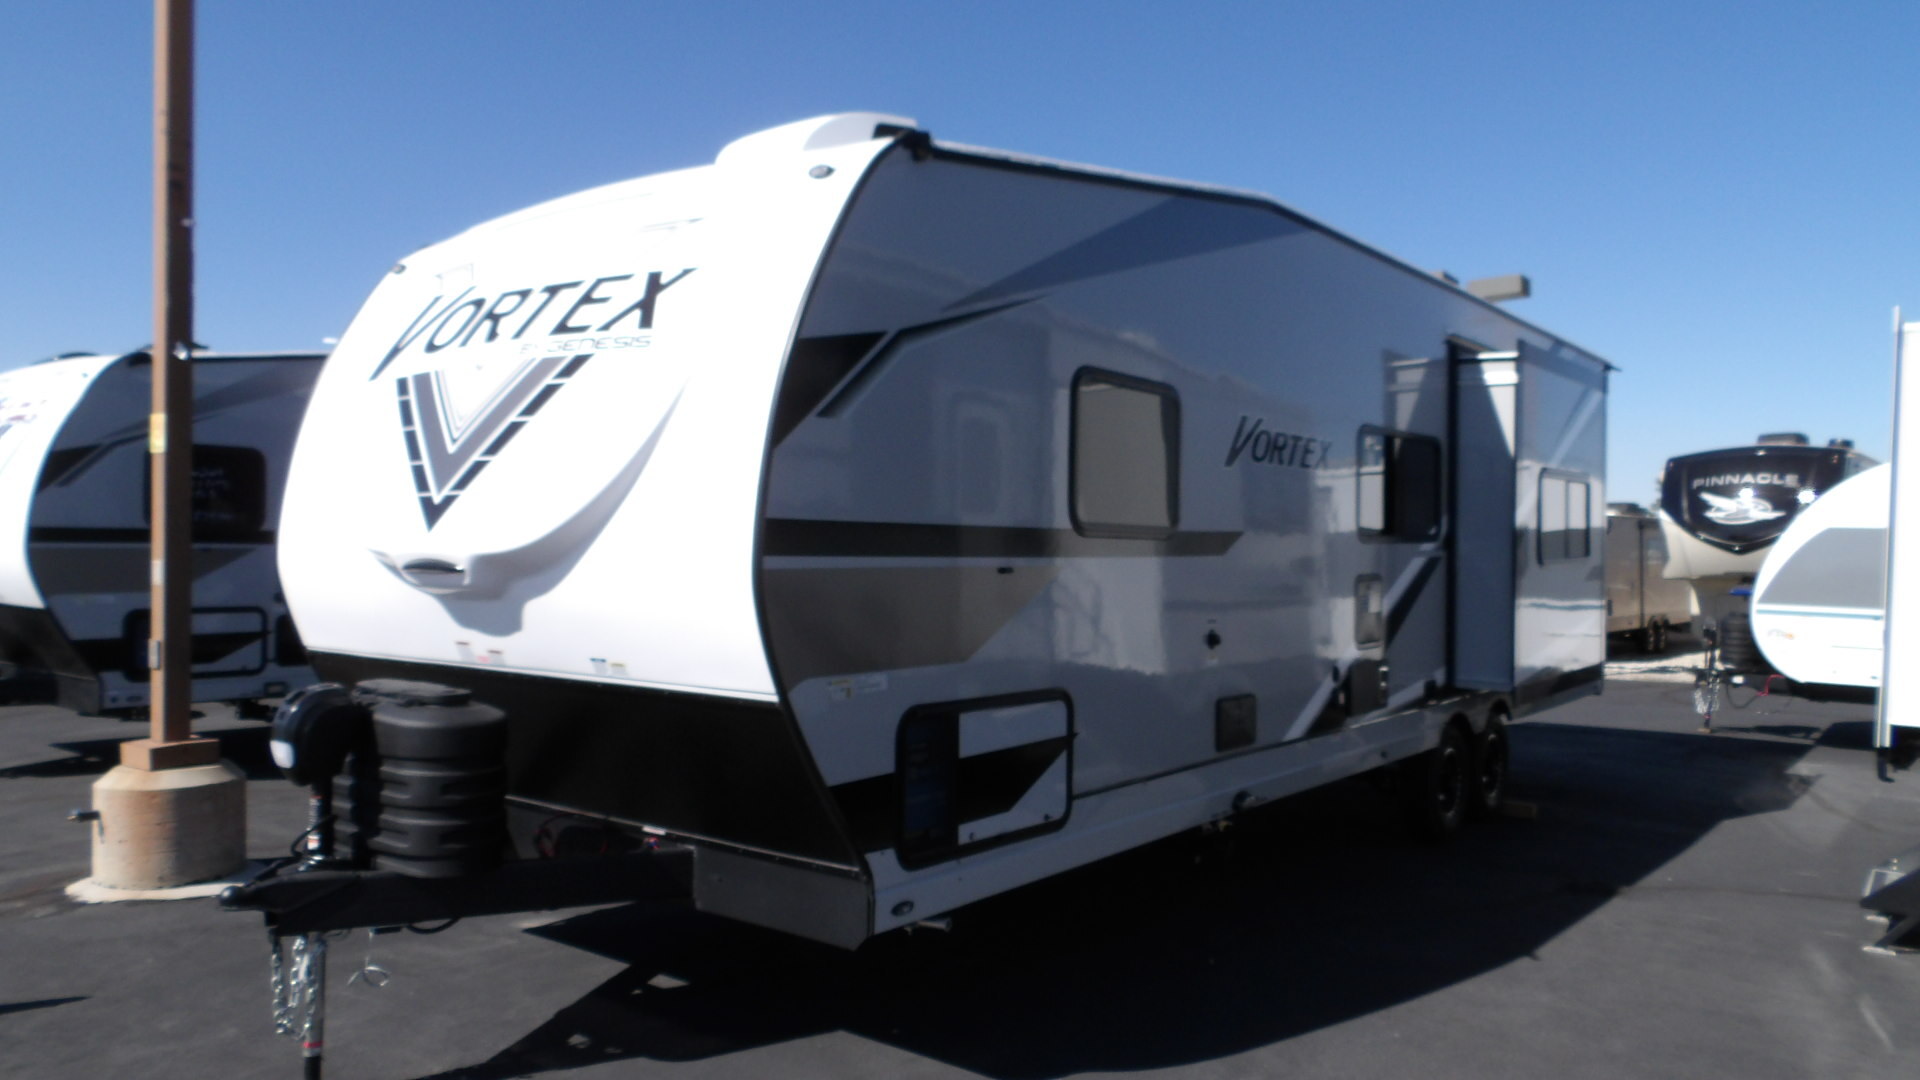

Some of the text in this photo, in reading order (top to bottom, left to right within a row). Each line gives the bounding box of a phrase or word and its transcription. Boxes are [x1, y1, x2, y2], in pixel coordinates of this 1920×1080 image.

[368, 267, 698, 381] VORTEX
[547, 336, 652, 353] GENESIS
[1224, 415, 1332, 469] VORTEX
[1692, 473, 1799, 489] PINNACLE
